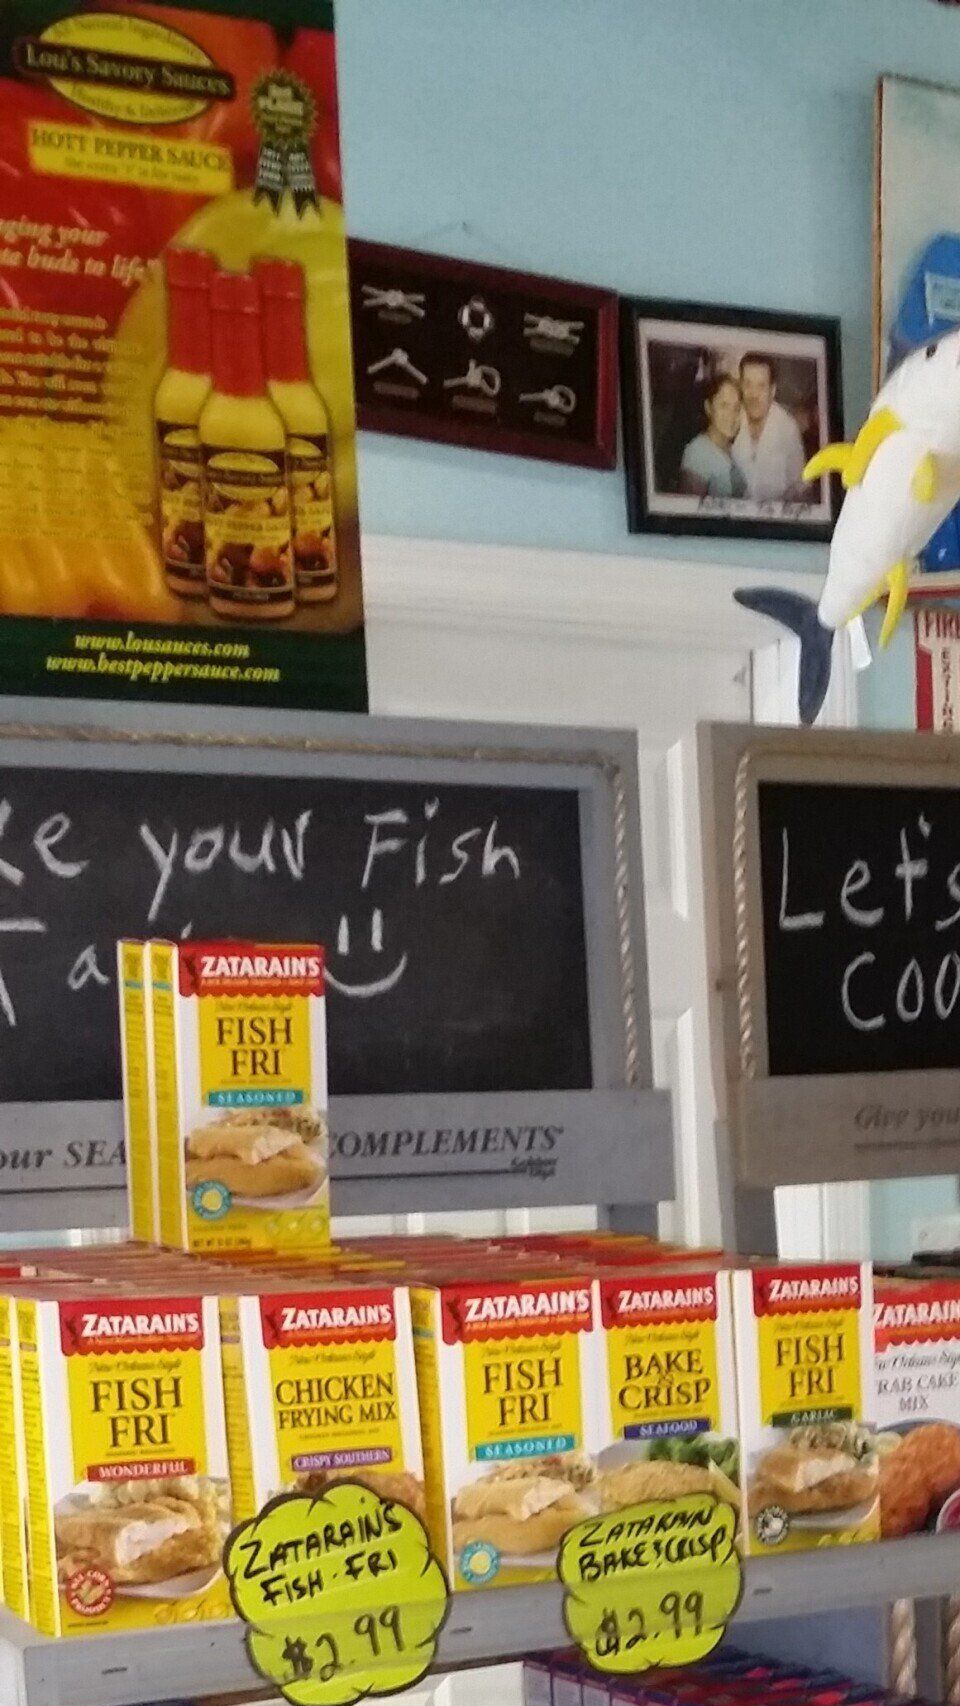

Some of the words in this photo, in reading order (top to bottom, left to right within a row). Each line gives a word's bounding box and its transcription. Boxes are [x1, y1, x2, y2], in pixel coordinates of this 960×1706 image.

[26, 44, 81, 75] Lou's
[85, 56, 155, 86] Savory
[160, 68, 232, 97] Sauces
[94, 136, 163, 164] PEPPER
[167, 146, 230, 172] SAUCE
[74, 631, 251, 659] www.lousauces.com
[46, 651, 281, 683] www.bestpeppersauce.com
[140, 808, 313, 922] your
[361, 797, 521, 889] Fish
[201, 954, 321, 979] ZATARAIN'S
[216, 1016, 293, 1047] FISH
[231, 1048, 284, 1077] FRI
[216, 1090, 298, 1107] SEASONED
[617, 1286, 714, 1314] ZATARAIN'S
[769, 1276, 859, 1302] ZATARAIN'S
[281, 1304, 392, 1332] ZATARAIN'S
[464, 1289, 590, 1324] ZATARAIN'S
[81, 1312, 199, 1338] ZATARAIN'S
[624, 1349, 704, 1382] BAKE
[775, 1333, 844, 1367] FISH
[275, 1372, 394, 1406] CHICKEN
[483, 1357, 564, 1394] FISH
[789, 1367, 834, 1398] FRI
[877, 1377, 913, 1396] RAB
[90, 1376, 184, 1413] FISH
[498, 1393, 552, 1427] FRI
[617, 1377, 712, 1411] CRISP
[108, 1414, 171, 1449] FRI
[278, 1406, 354, 1430] FRYING
[359, 1401, 397, 1423] MIX
[639, 1421, 698, 1437] SEAFOOD
[484, 1436, 567, 1458] SEASONED
[98, 1462, 189, 1480] WONDERFUL
[578, 1542, 650, 1583] BAKE
[594, 1590, 705, 1657] $2.99
[281, 1604, 406, 1683] $2.99
